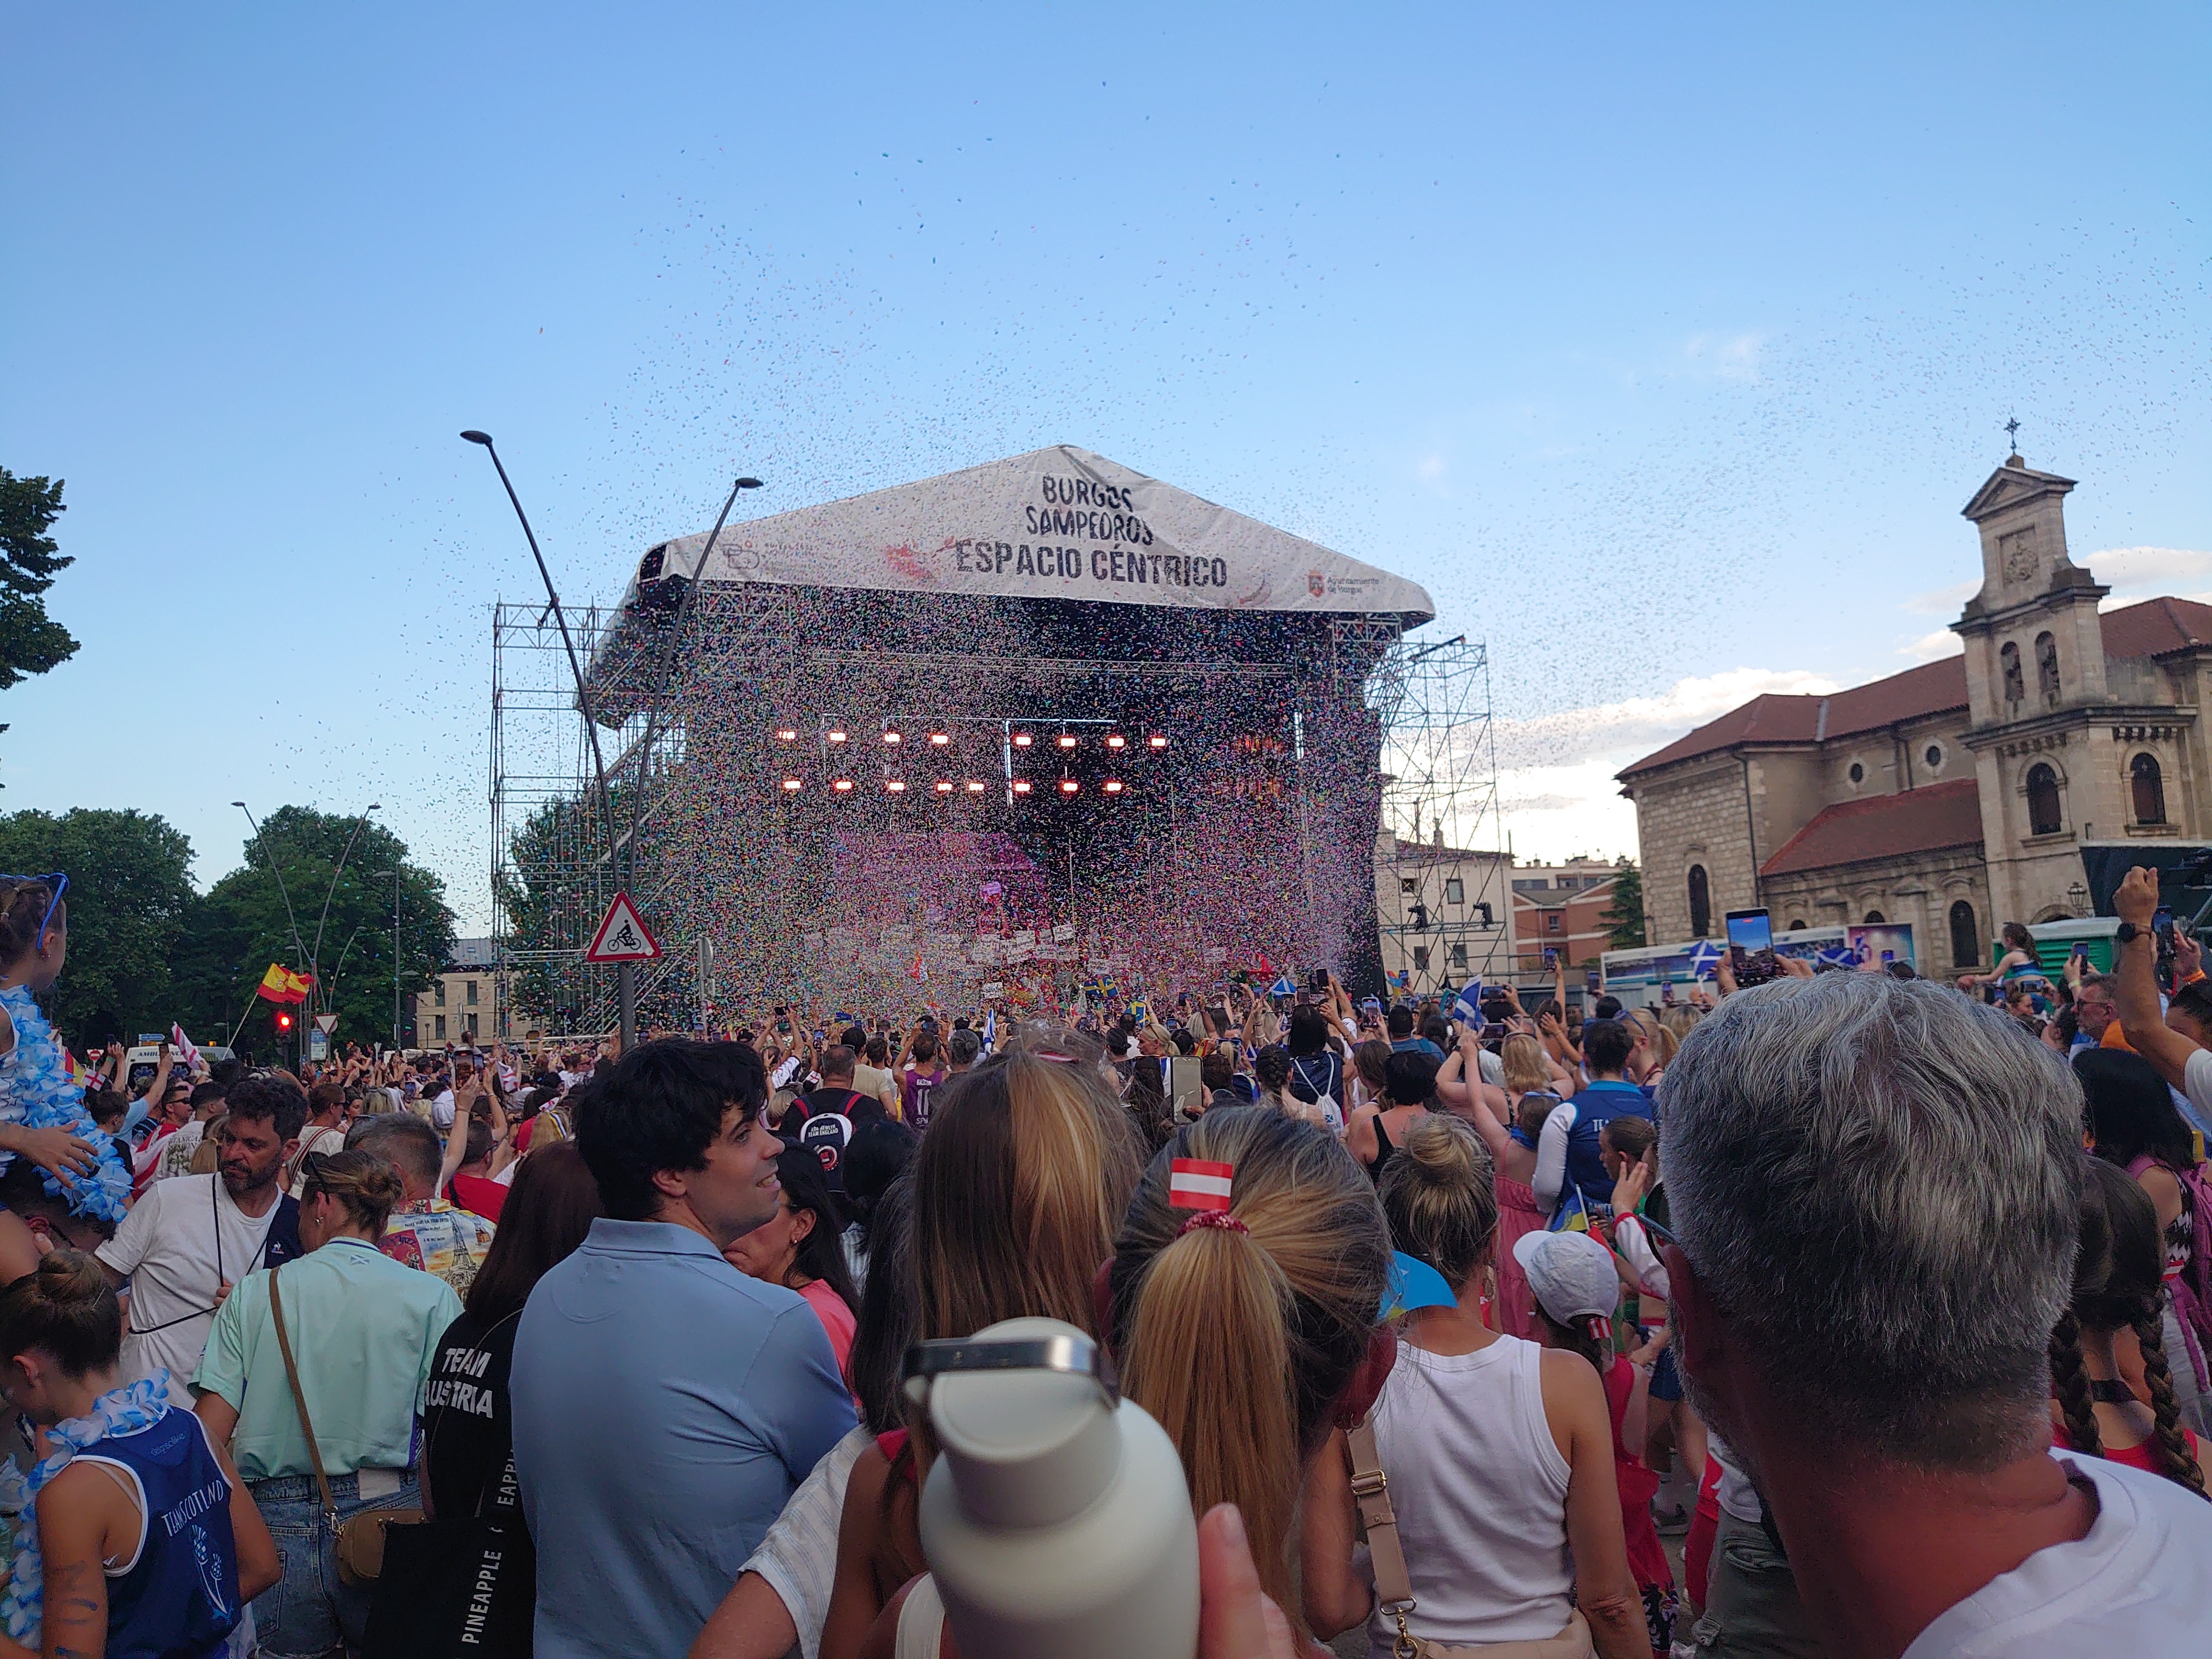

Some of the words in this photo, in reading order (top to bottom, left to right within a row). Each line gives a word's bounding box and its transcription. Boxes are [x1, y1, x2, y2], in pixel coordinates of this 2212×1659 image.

[1042, 475, 1133, 512] BURGOS
[1026, 505, 1154, 546] SAMPEDROS
[955, 538, 1082, 578] ESPACIO
[1091, 544, 1227, 588] CÉNTRICO
[820, 1127, 839, 1136] ENGLAND
[442, 1348, 492, 1378] TEAM
[425, 1380, 493, 1419] AUSTRIA
[461, 1550, 501, 1644] PINEAPPLE
